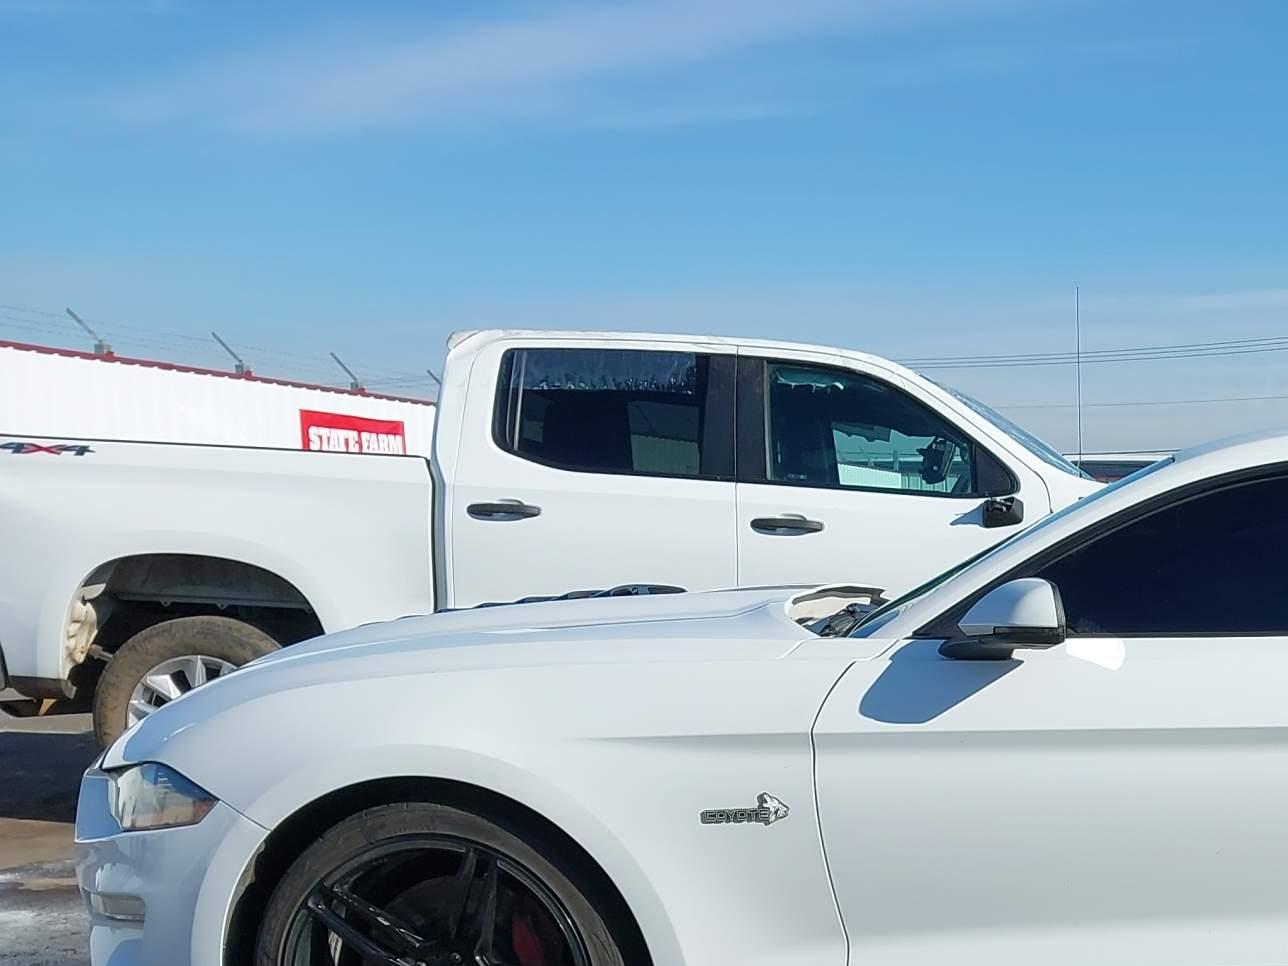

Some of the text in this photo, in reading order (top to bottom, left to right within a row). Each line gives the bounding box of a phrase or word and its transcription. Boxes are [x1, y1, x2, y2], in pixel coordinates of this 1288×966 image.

[308, 425, 403, 455] STATE FARM
[702, 809, 770, 823] COYOTE
